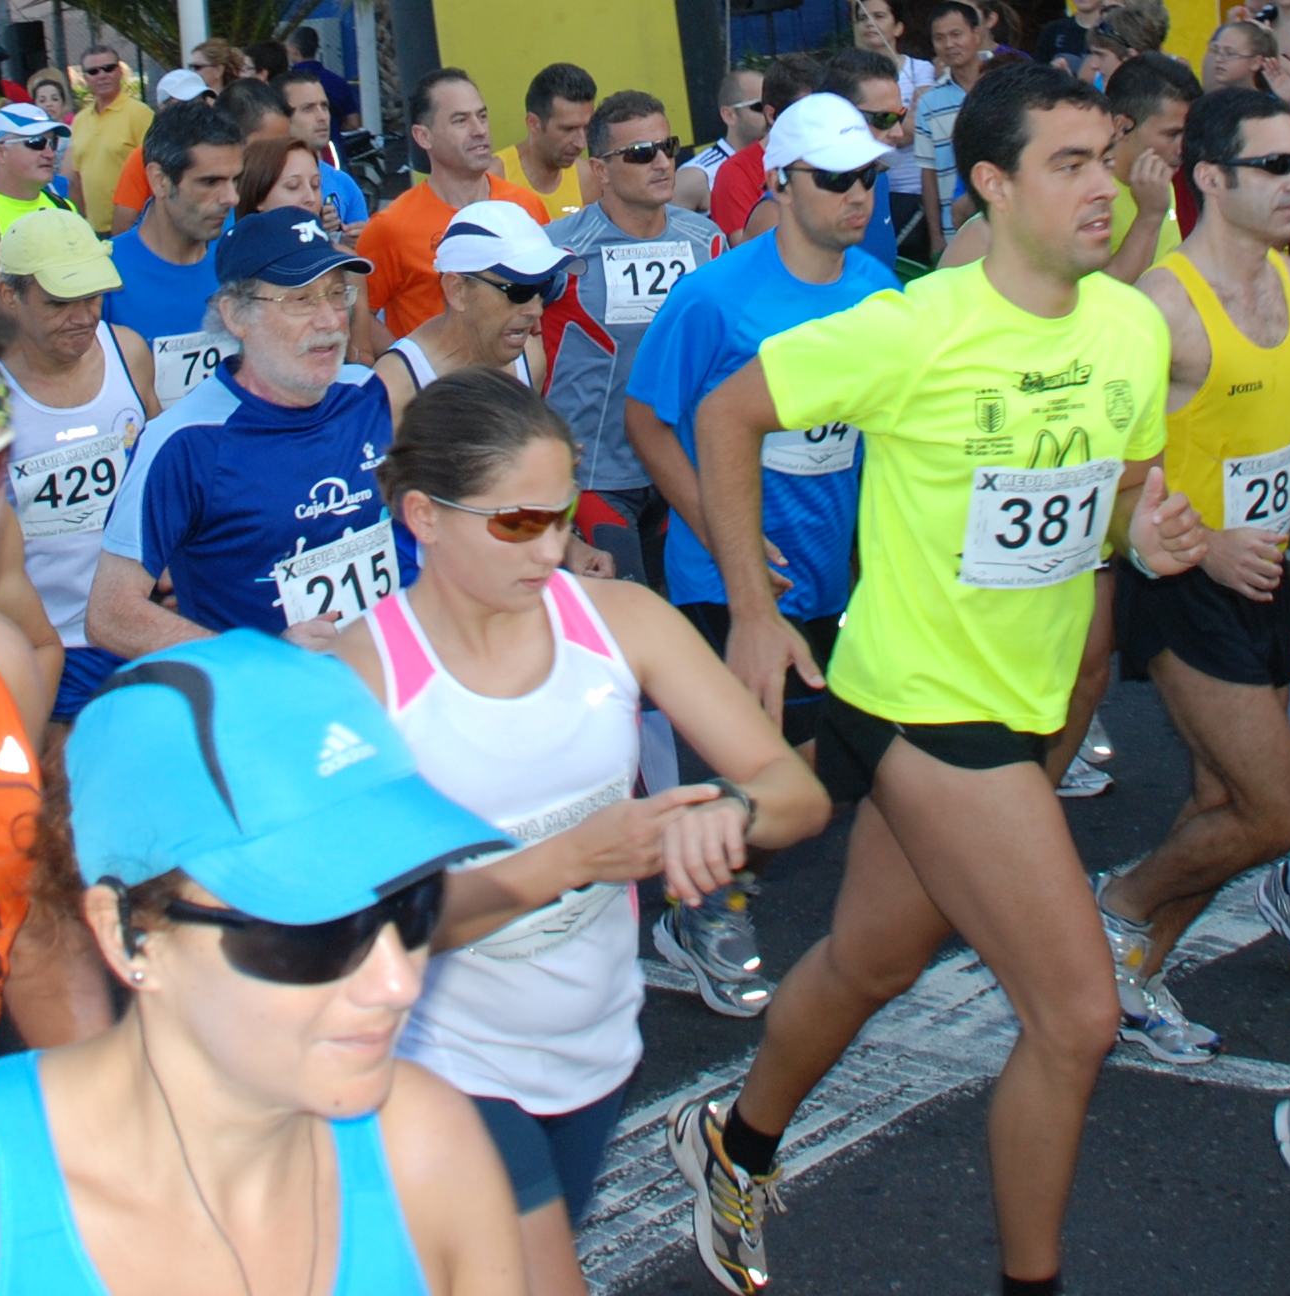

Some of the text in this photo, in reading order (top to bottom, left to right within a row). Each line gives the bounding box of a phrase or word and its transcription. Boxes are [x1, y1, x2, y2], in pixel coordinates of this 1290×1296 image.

[33, 457, 116, 509] 429
[976, 472, 999, 491] X
[995, 486, 1099, 549] 381
[306, 550, 392, 621] 215
